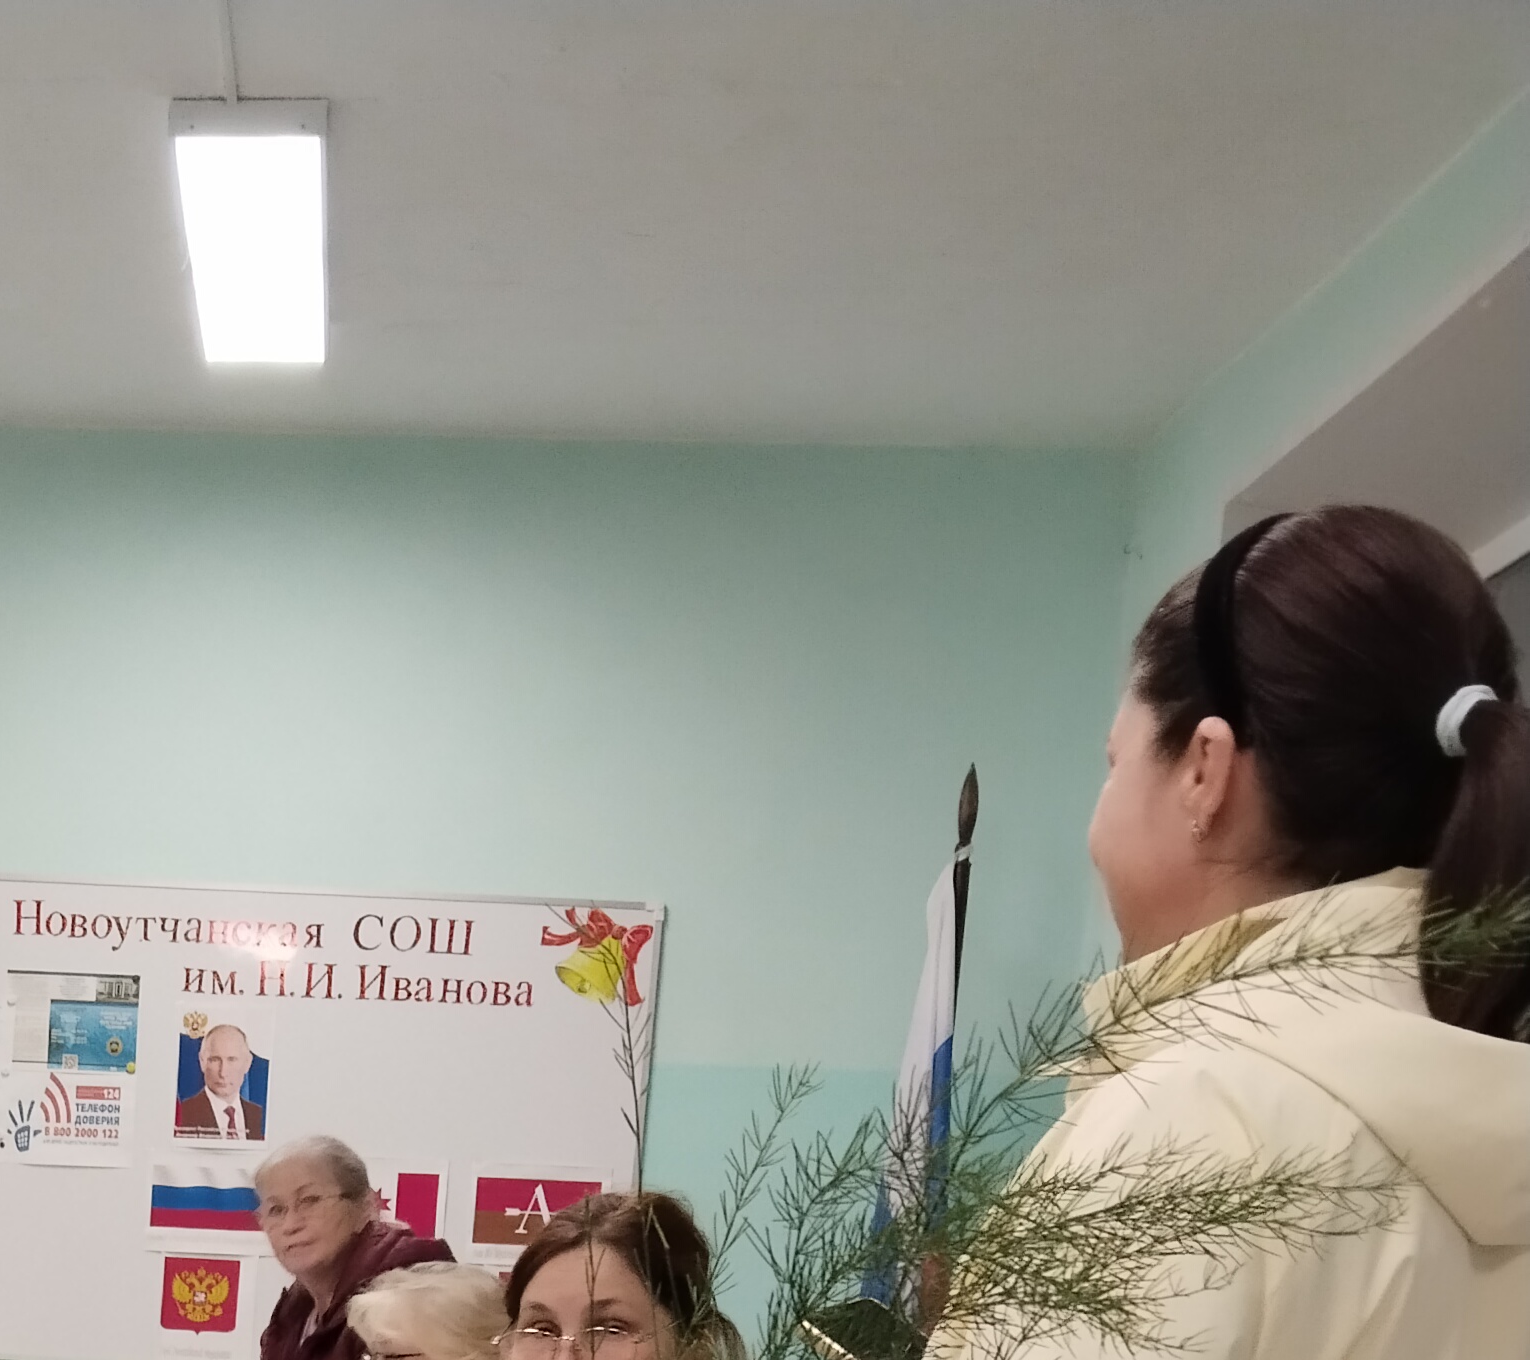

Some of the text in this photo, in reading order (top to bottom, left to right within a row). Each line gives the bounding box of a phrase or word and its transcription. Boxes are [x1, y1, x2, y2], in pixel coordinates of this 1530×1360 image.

[13, 899, 325, 951] Новоутчанская
[352, 914, 476, 955] СОШ
[181, 966, 245, 996] им.
[355, 964, 534, 1008] Иванова
[103, 1088, 120, 1099] 124
[75, 1103, 121, 1113] ТЕЛЕФОН
[74, 1115, 120, 1126] ДОВЕРИЯ
[53, 1127, 72, 1137] 800
[74, 1128, 99, 1138] 2000
[102, 1129, 119, 1139] 122
